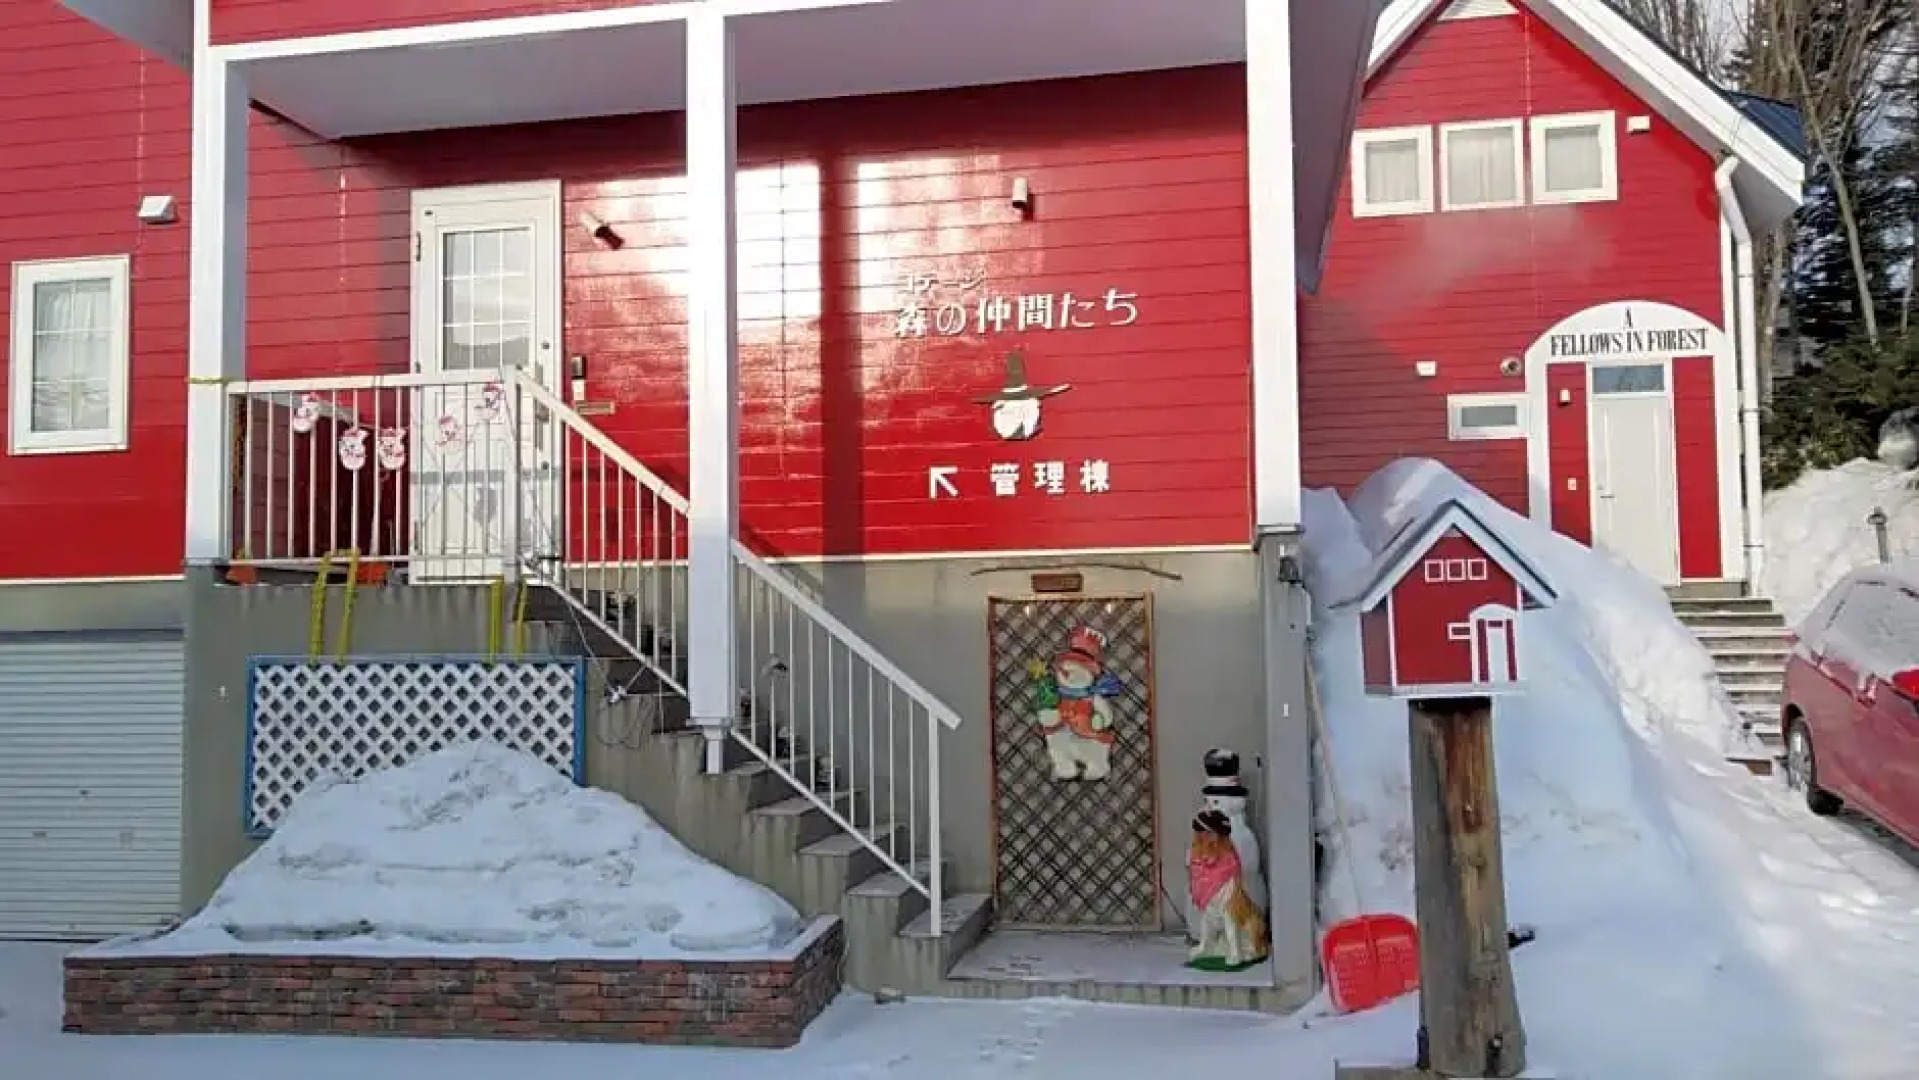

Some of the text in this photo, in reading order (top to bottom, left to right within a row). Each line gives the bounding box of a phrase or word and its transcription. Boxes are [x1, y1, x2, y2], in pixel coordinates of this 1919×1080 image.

[896, 288, 1138, 335] 森の仲間たち
[1625, 307, 1633, 328] A
[1551, 328, 1706, 356] FELLOWS IN FOREST
[990, 459, 1109, 495] 管理棟
